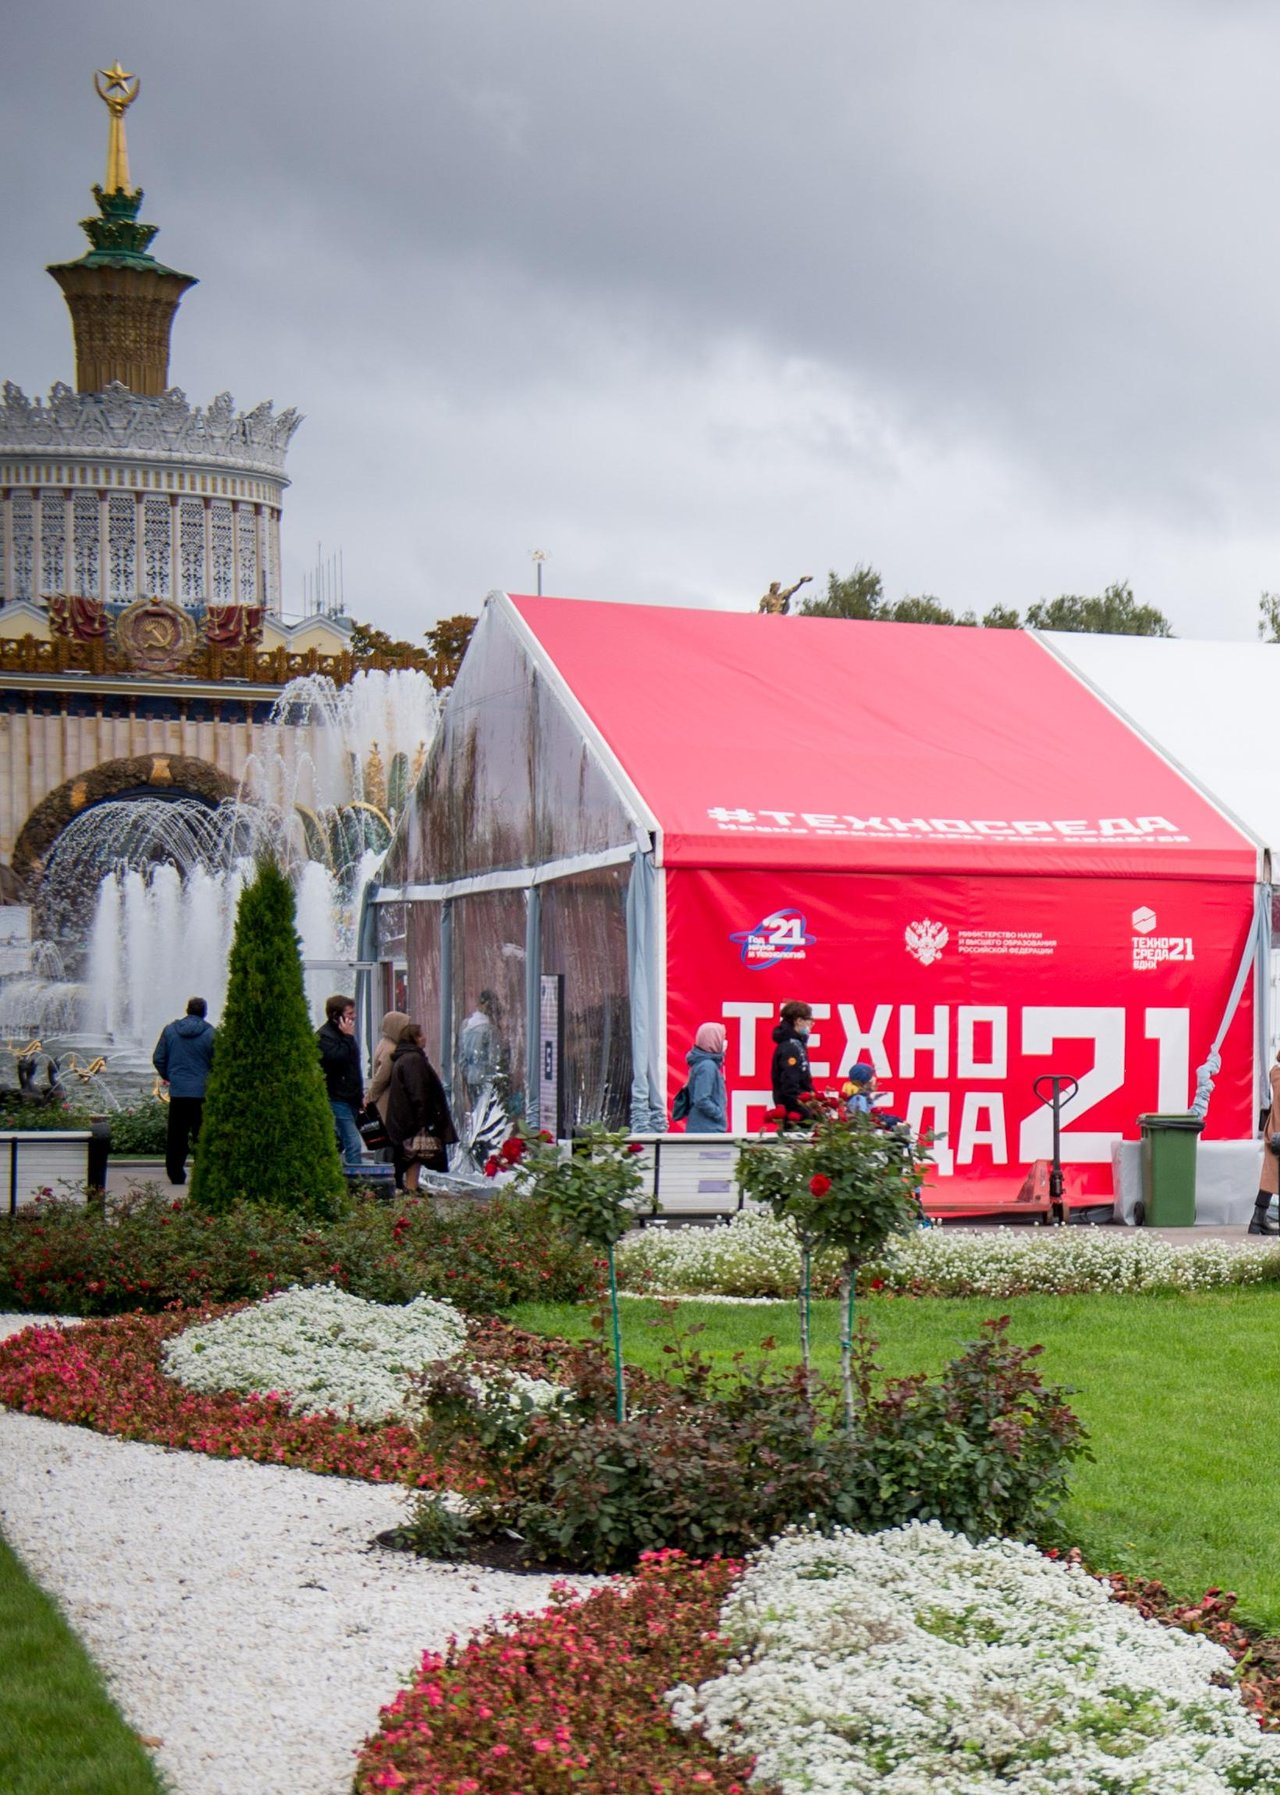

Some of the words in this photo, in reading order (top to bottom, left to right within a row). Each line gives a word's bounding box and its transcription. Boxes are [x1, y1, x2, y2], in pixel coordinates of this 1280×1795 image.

[707, 807, 1180, 836] #ТЕХНОСРЕДА
[1132, 937, 1169, 948] ТЕХНО
[1169, 937, 1195, 960] 21
[1133, 948, 1169, 961] СРЕДА
[1020, 1006, 1190, 1163] 21
